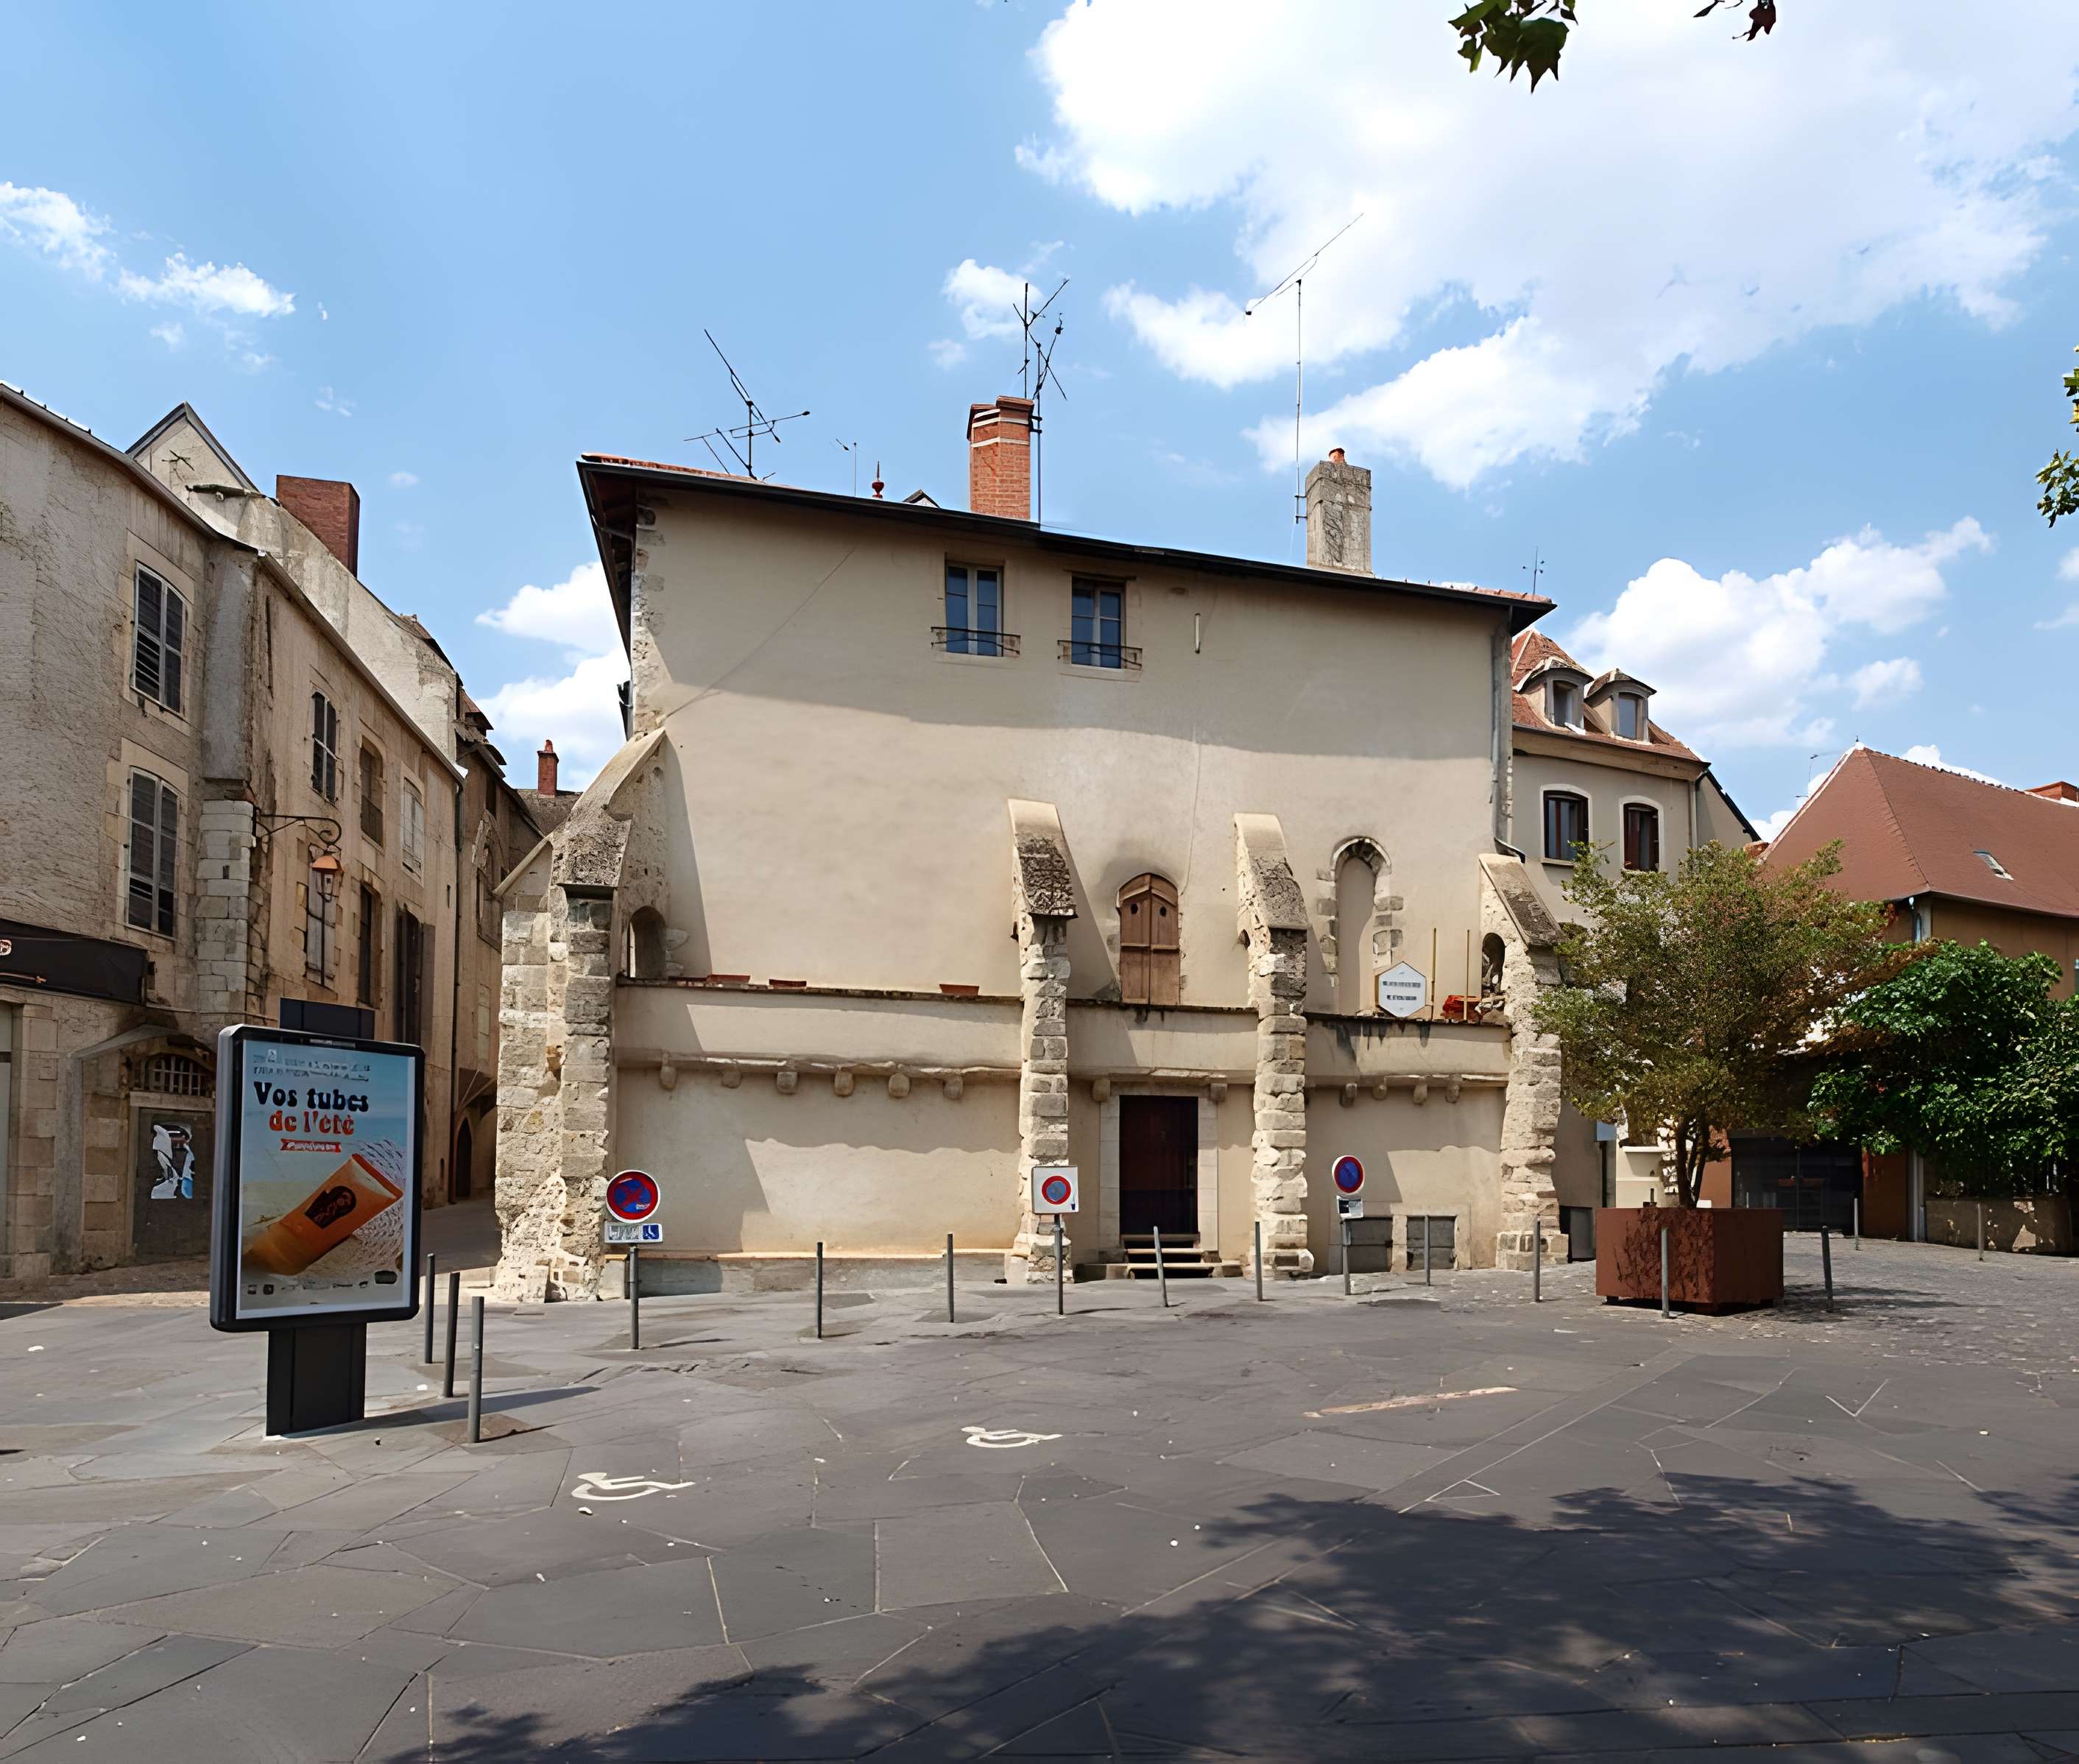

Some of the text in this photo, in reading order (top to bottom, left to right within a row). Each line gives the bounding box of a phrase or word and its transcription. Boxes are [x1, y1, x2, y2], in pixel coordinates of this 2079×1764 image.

[253, 1081, 369, 1112] Vos tubes
[269, 1109, 297, 1132] de
